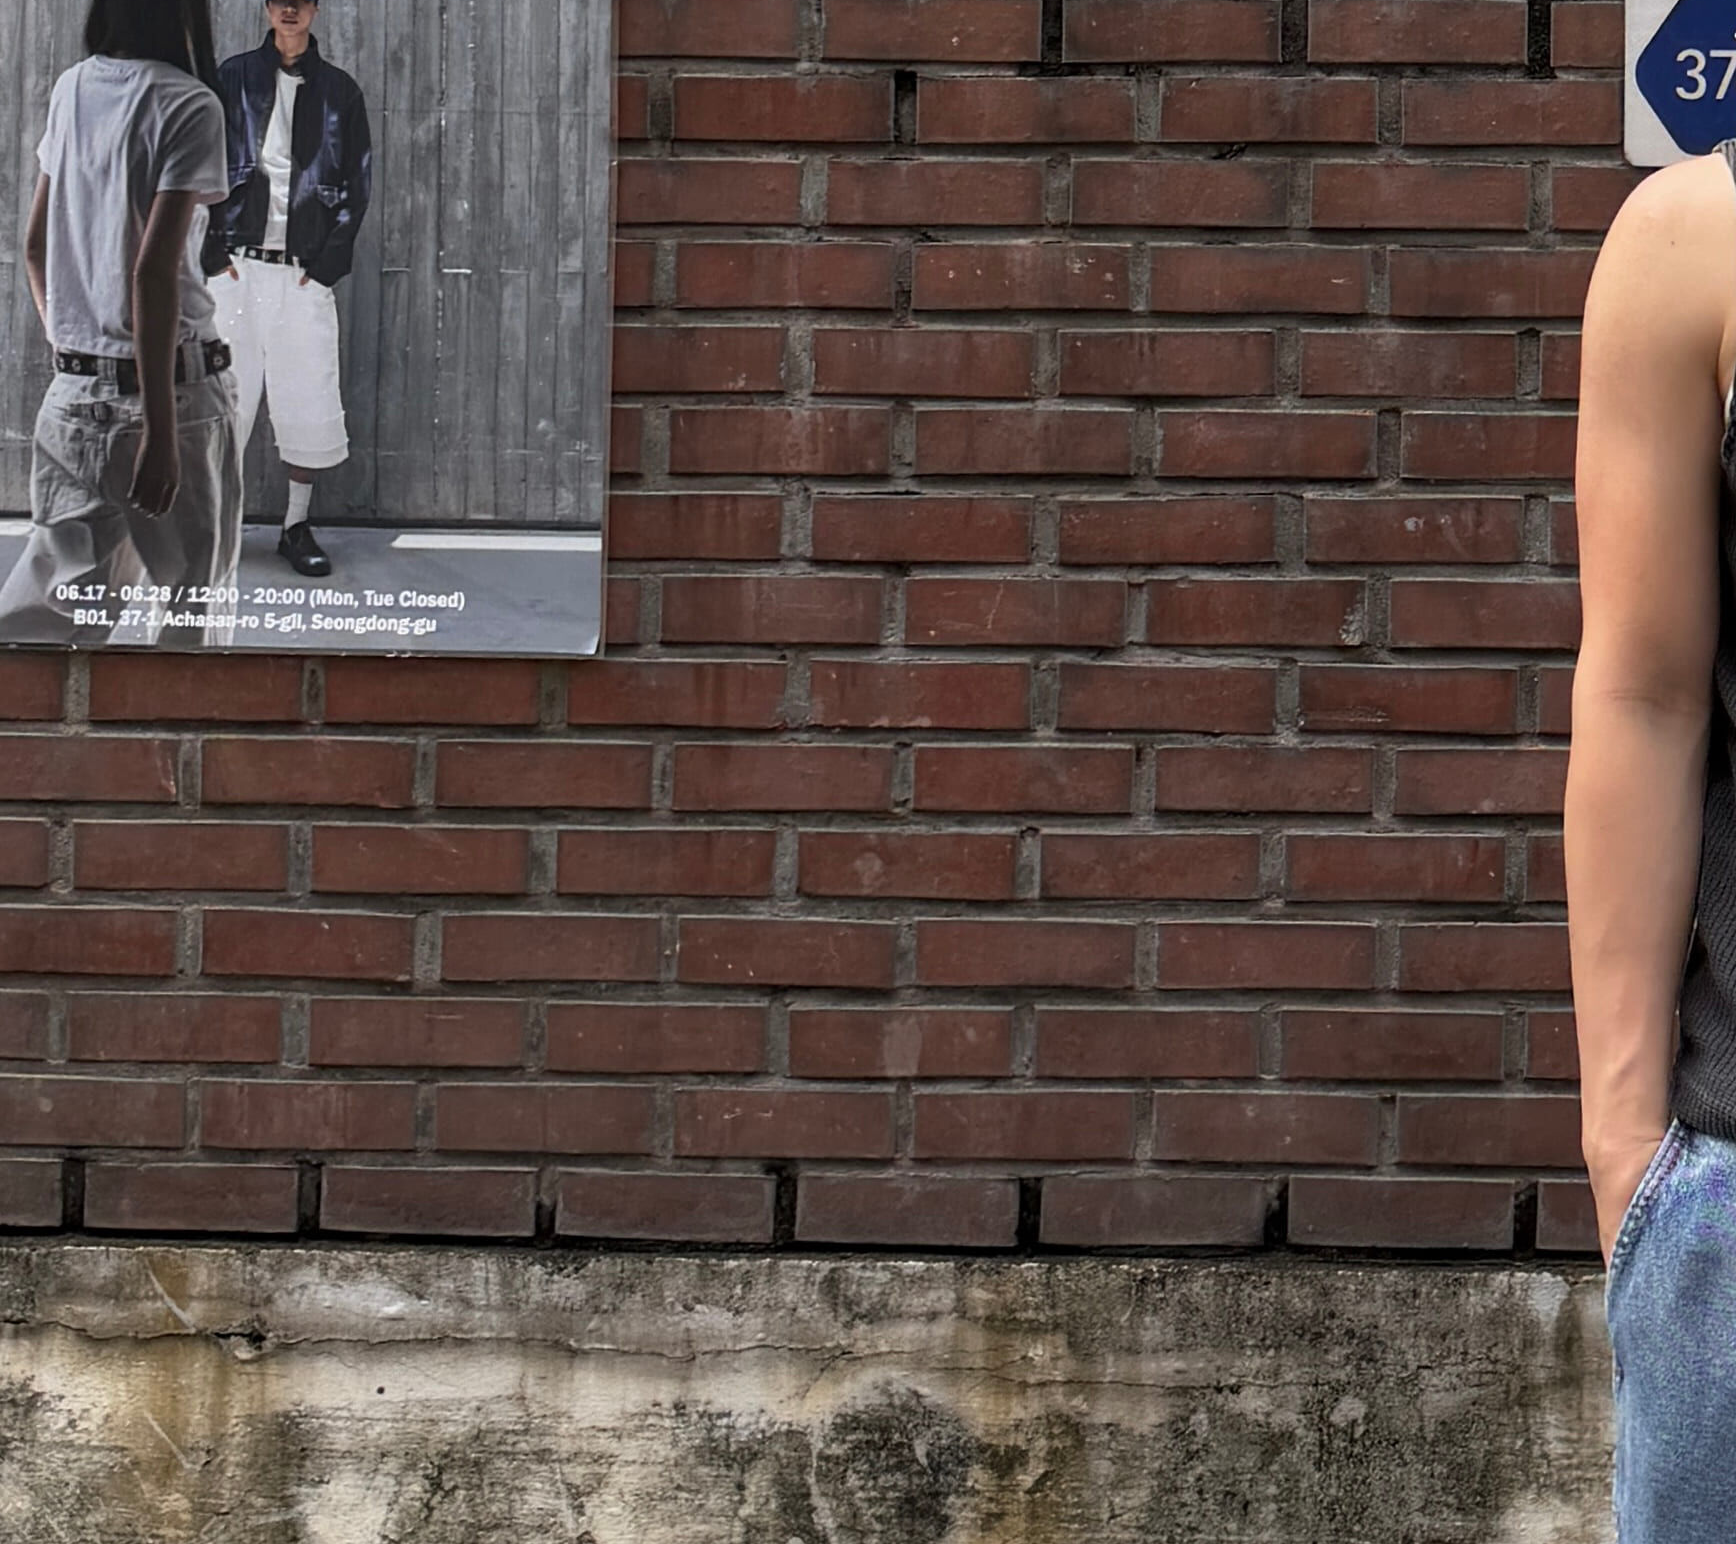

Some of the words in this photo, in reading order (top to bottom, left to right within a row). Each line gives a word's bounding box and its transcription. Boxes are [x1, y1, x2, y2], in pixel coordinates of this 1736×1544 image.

[55, 585, 106, 601] 06.17
[120, 585, 171, 602] 06.28
[187, 586, 239, 603] 12:00
[252, 588, 305, 605] 20:00
[309, 589, 359, 608] (Mon,
[363, 590, 394, 606] Tue
[399, 591, 465, 610] Closed)
[73, 609, 114, 628] B01,
[162, 611, 259, 628] Achasan-ro
[264, 613, 307, 632] 5-gil,
[311, 614, 437, 635] Seongdong-gu
